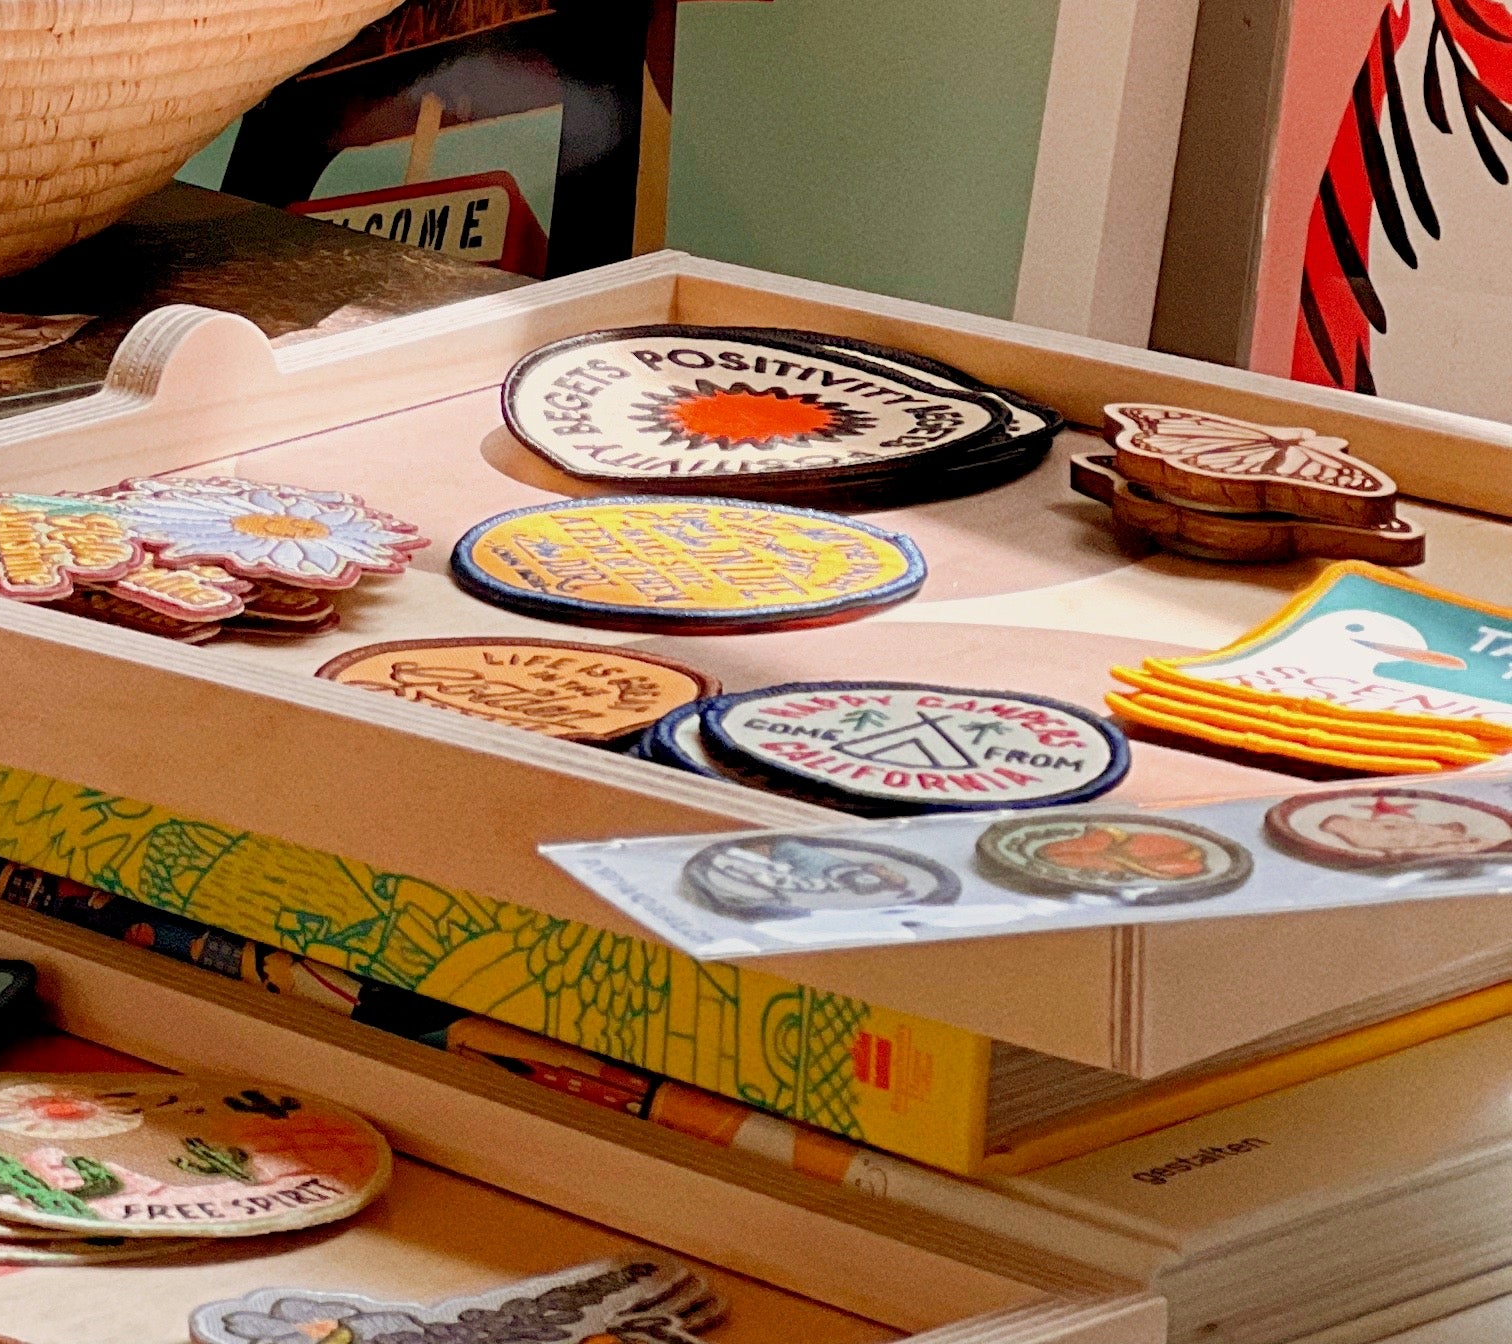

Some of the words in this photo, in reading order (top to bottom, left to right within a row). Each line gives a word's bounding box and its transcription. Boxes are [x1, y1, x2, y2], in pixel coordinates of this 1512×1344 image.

[543, 359, 632, 435] BEGETS
[632, 348, 929, 405] POSITIVITY
[743, 718, 842, 742] COME
[984, 746, 1085, 772] FROM
[758, 696, 893, 722] HAPPY
[916, 698, 1087, 749] CAMPERS
[760, 740, 1042, 794] CALIFORNIA
[1132, 1135, 1271, 1185] gestalten
[122, 1201, 222, 1220] FREE
[230, 1177, 344, 1214] SPIRIT
